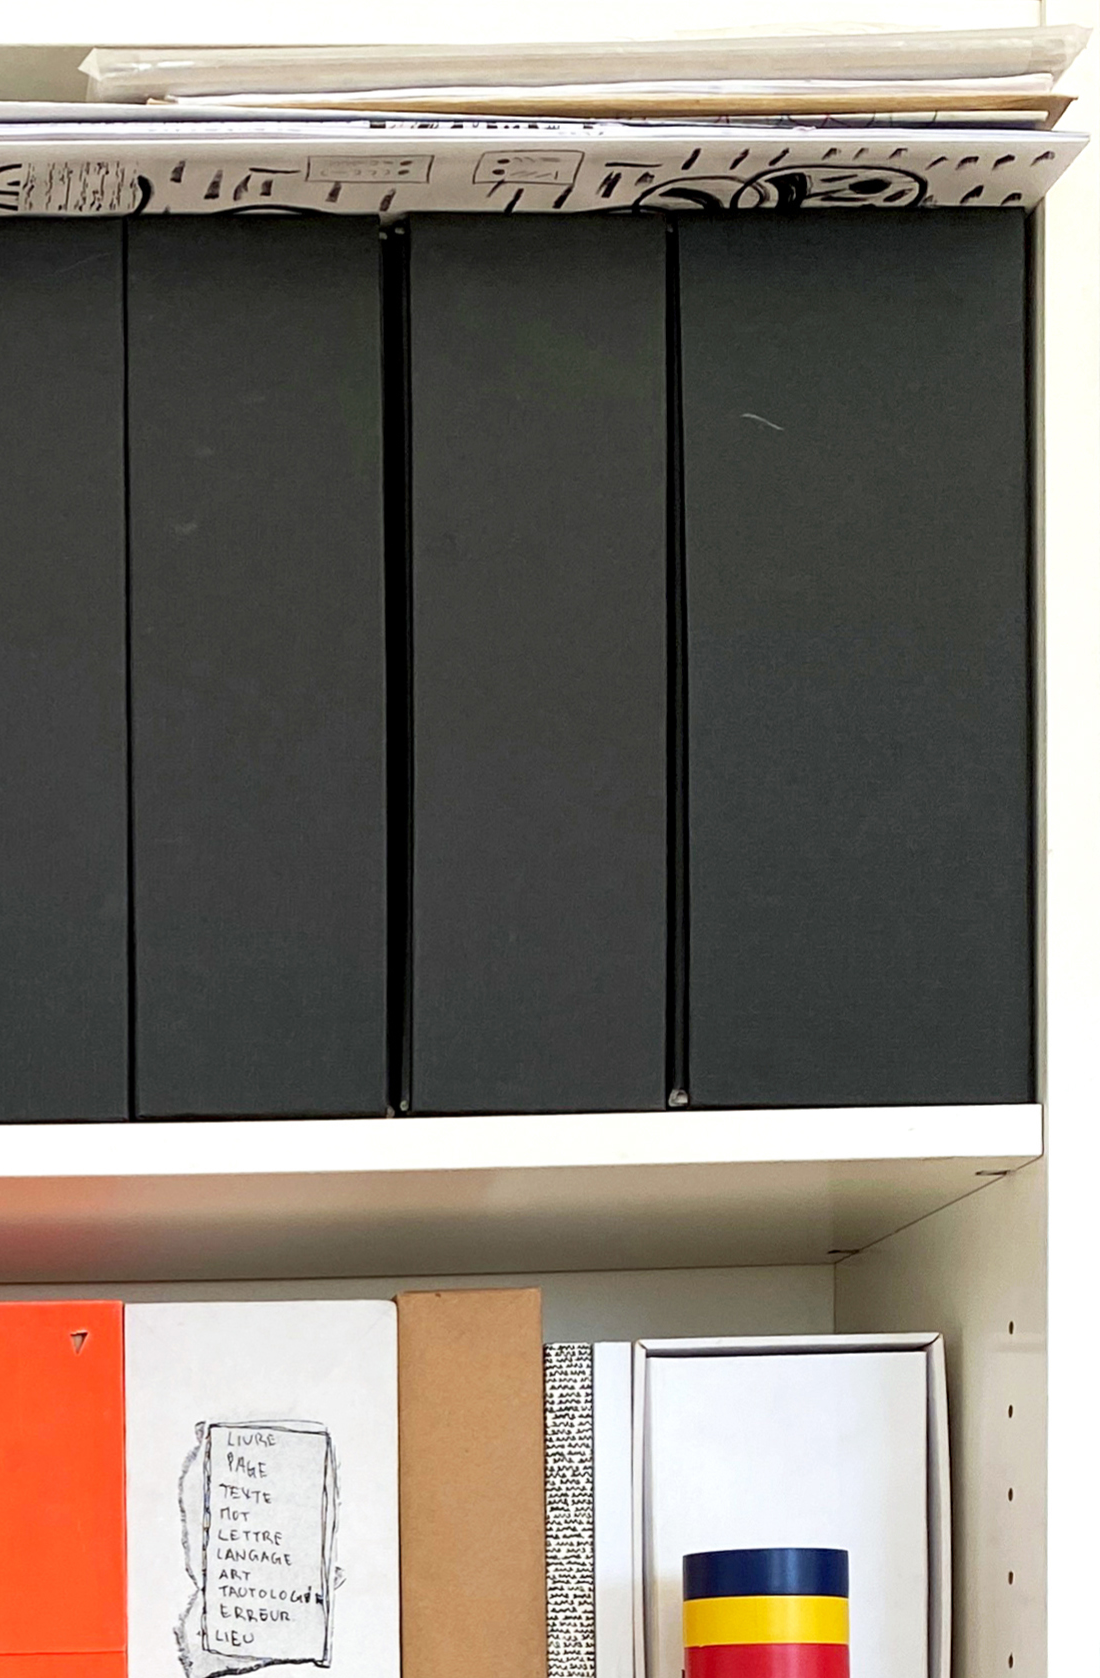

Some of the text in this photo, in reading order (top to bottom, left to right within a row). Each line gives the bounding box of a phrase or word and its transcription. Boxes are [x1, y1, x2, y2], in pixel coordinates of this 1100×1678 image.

[227, 1432, 276, 1447] LIVRE
[227, 1451, 267, 1479] PAGE
[220, 1507, 250, 1522] MOT
[218, 1529, 282, 1546] LETTRE
[217, 1549, 293, 1566] LANGAGE
[219, 1569, 251, 1581] ART
[220, 1605, 291, 1622] ERREUR
[215, 1629, 255, 1645] LIEU
